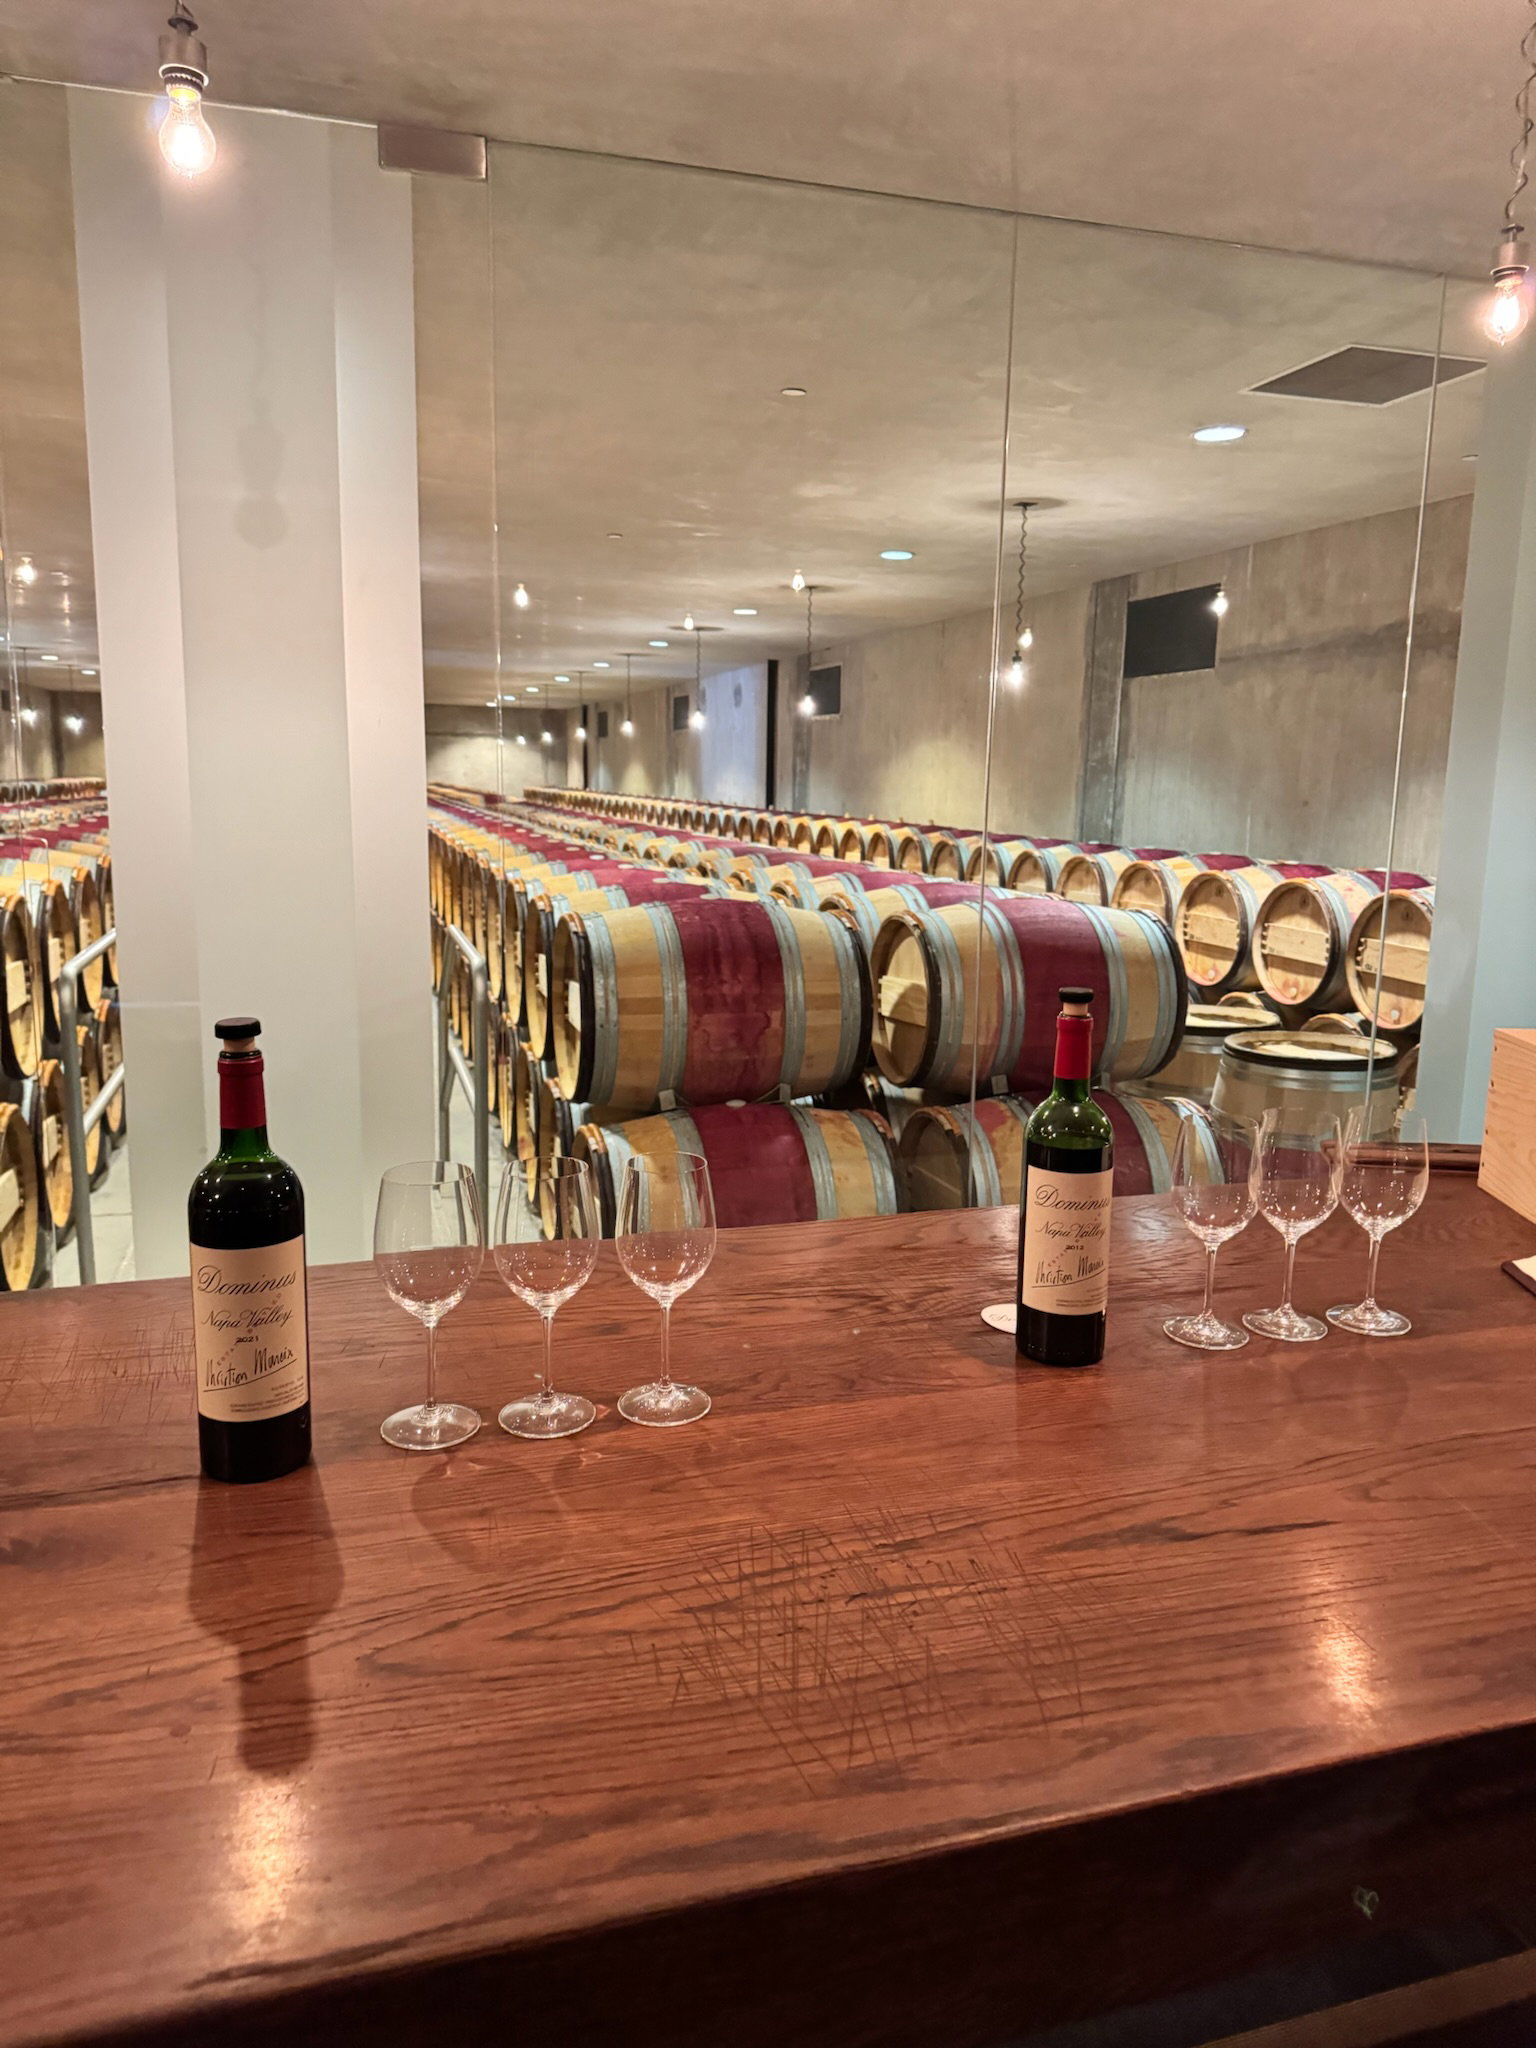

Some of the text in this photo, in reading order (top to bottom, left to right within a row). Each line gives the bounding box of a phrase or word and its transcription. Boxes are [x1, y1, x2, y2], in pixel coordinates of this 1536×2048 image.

[1034, 1184, 1110, 1211] Dominus
[1035, 1221, 1106, 1240] Napa Valley
[197, 1264, 297, 1296] Dominus
[201, 1304, 293, 1331] Napa Valley
